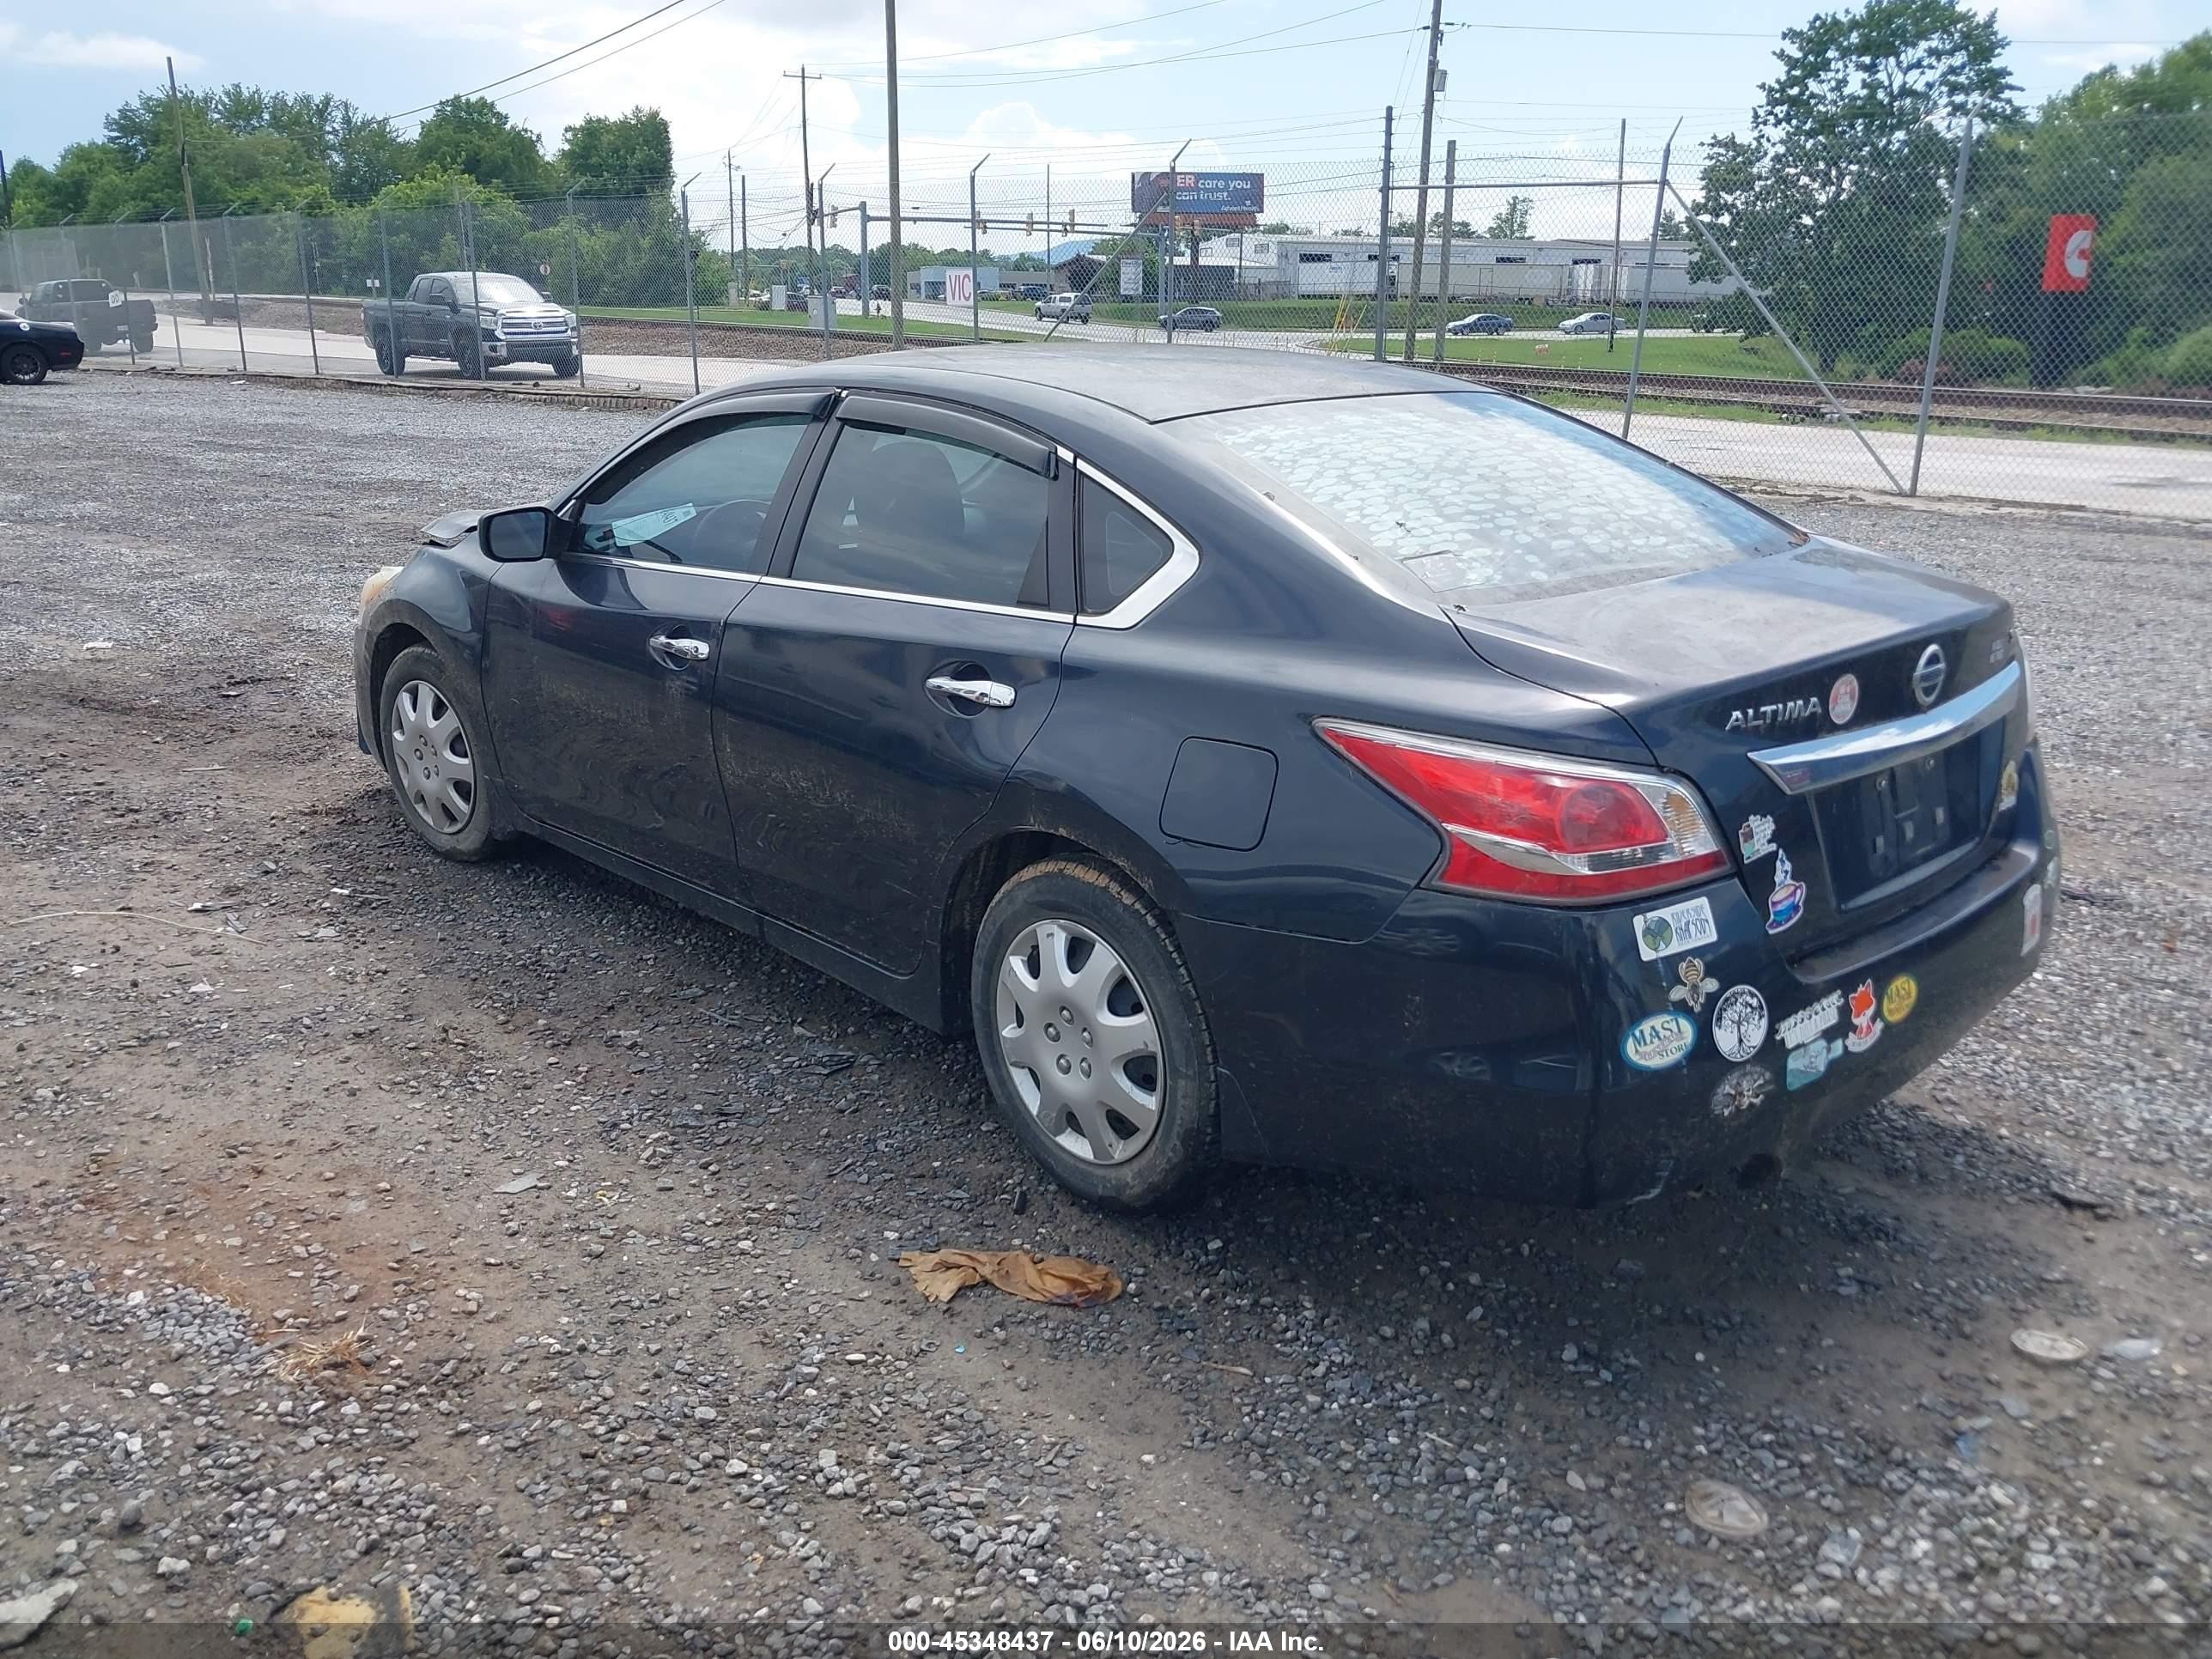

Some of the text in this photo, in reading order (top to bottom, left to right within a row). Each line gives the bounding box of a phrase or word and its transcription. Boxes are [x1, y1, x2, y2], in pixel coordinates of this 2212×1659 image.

[1176, 174, 1251, 191] ER care you
[1176, 191, 1231, 201] can trust.
[948, 273, 972, 302] VIC
[1725, 696, 1822, 731] ALTIMA
[1630, 1017, 1682, 1054] MAST
